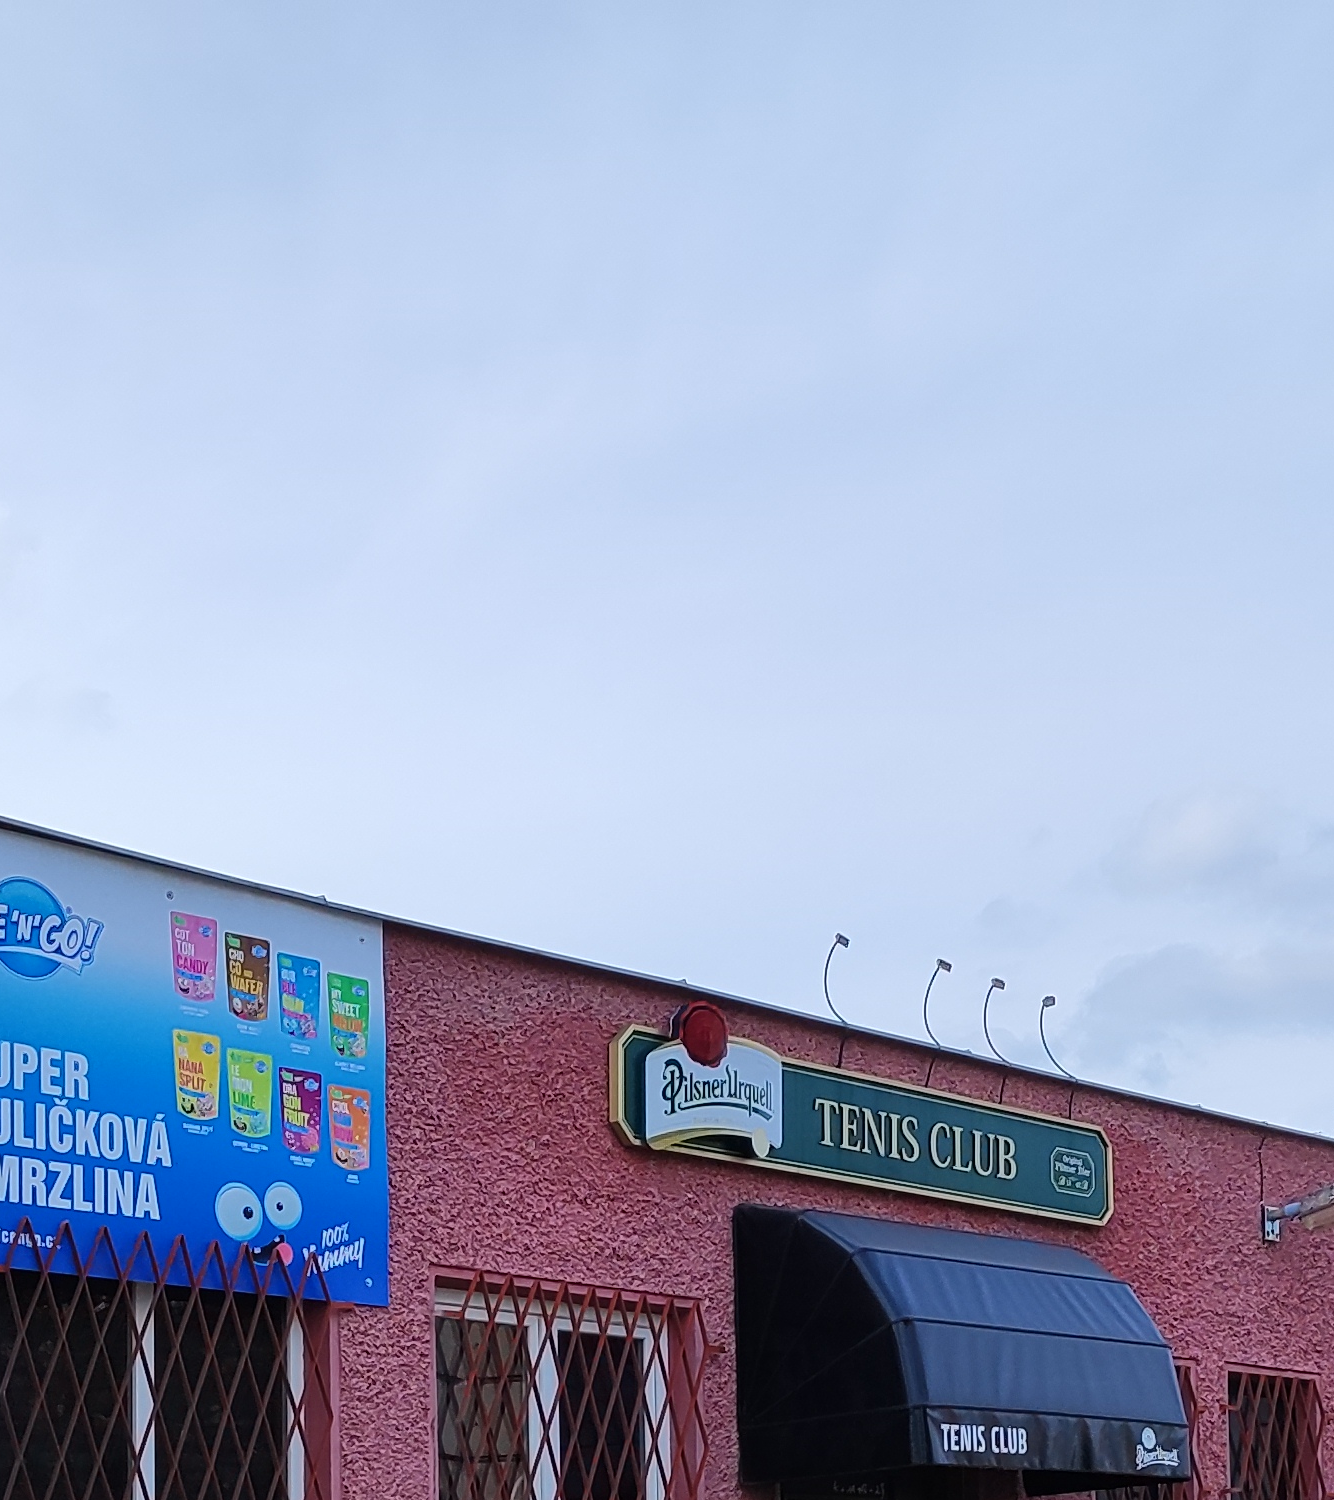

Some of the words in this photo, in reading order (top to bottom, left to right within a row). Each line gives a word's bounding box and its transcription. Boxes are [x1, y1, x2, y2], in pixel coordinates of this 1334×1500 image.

[176, 955, 208, 974] CANDY
[230, 975, 264, 996] WAFER
[331, 1000, 361, 1018] SWEET
[178, 1058, 204, 1074] NANA
[179, 1072, 206, 1092] SPLIT
[661, 1058, 727, 1116] Pilsner
[725, 1064, 772, 1118] Urquell
[284, 1108, 310, 1128] FRUIT
[814, 1098, 921, 1163] TENIS
[929, 1122, 1018, 1180] CLUB
[321, 1221, 350, 1250] 100%
[940, 1423, 987, 1454] TENIS
[990, 1425, 1028, 1455] CLUB
